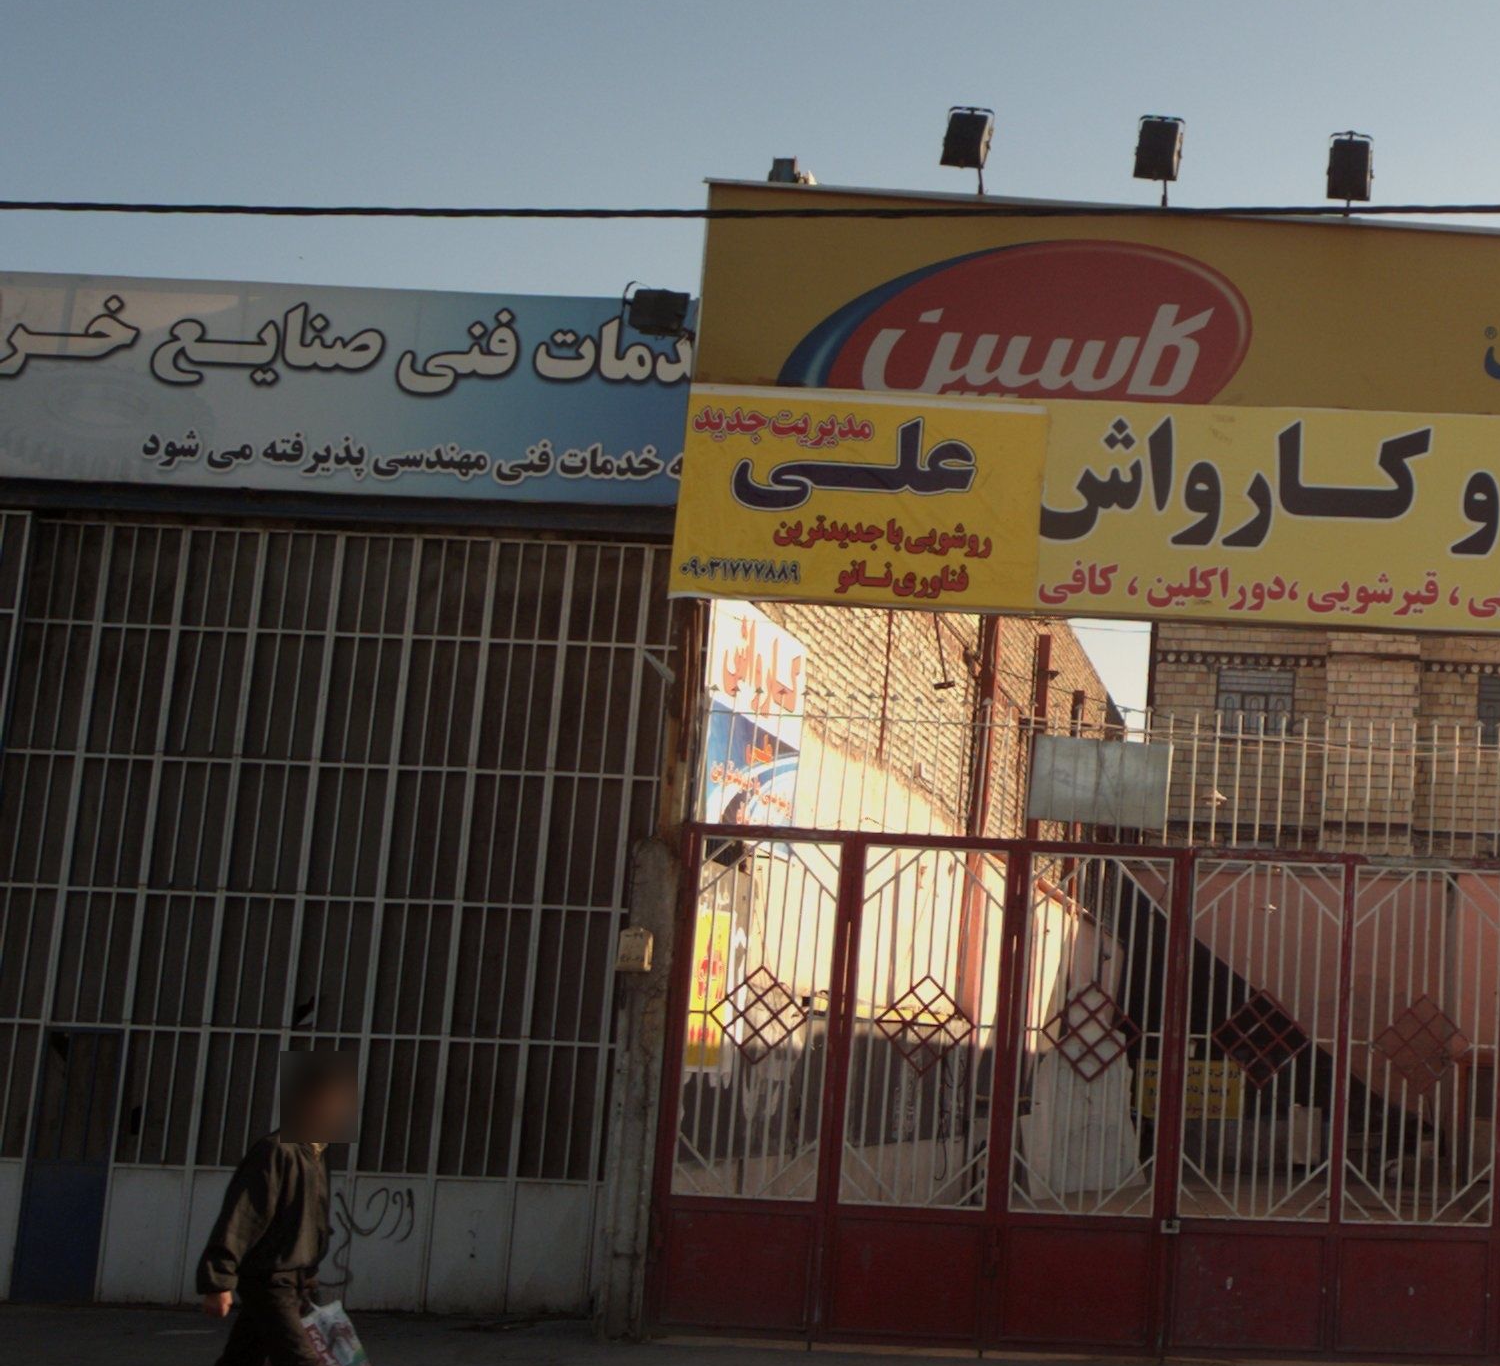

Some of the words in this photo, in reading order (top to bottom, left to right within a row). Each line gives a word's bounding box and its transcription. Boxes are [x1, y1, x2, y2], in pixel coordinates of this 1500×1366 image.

[150, 302, 386, 386] صنایع
[396, 307, 520, 395] فنی
[533, 316, 694, 385] دمات
[693, 405, 769, 444] جدید
[770, 409, 874, 448] مدیریت
[142, 431, 200, 462] شود
[206, 442, 253, 469] می
[262, 433, 365, 477] پذیرفته
[373, 445, 488, 477] مهندسی
[496, 441, 550, 483] فنی
[560, 444, 660, 481] خدمات
[730, 417, 978, 512] علی
[1039, 414, 1432, 549] کارواش
[772, 514, 884, 550] جدیدترین
[1450, 470, 1500, 556] و
[886, 517, 904, 551] با
[904, 522, 993, 558] روشویی
[834, 559, 893, 594] نانو
[893, 564, 970, 599] فناوری
[1038, 560, 1119, 604] کافی
